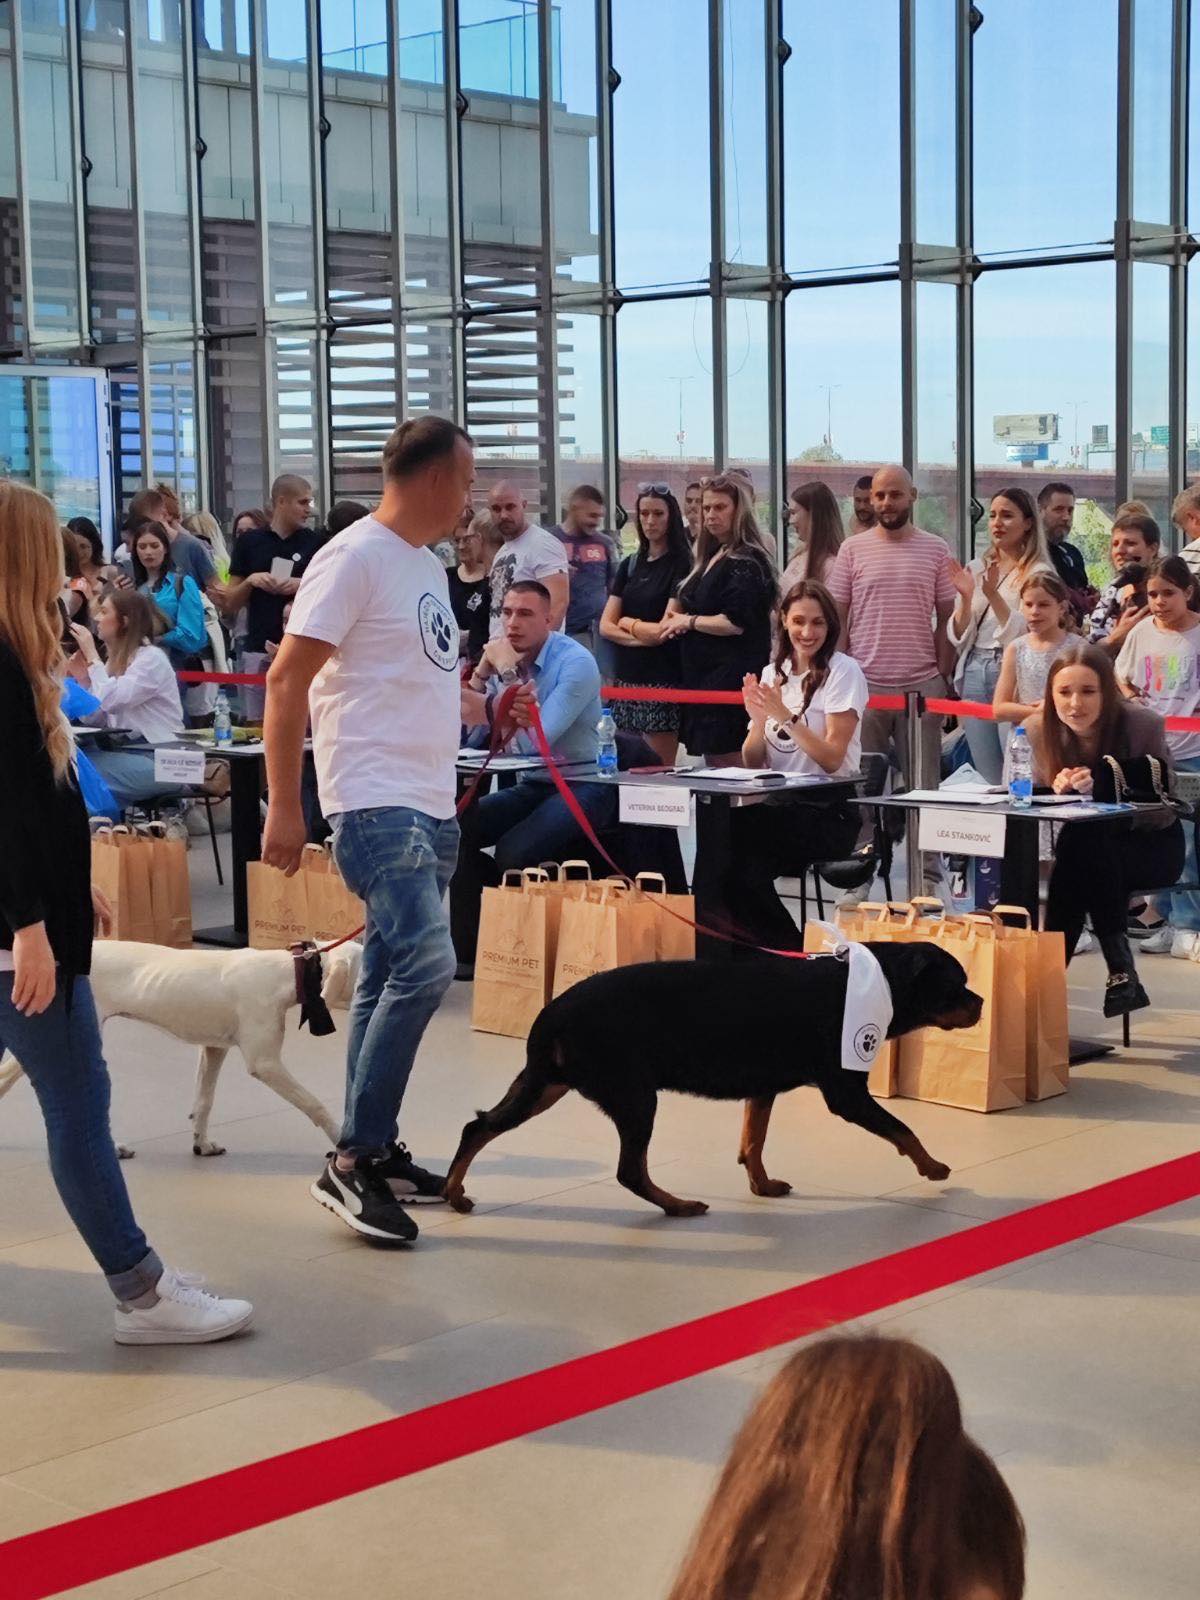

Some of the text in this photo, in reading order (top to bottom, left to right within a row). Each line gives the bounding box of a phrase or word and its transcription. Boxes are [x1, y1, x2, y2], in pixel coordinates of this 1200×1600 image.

[627, 803, 686, 813] VETERINA BEOGRAD
[936, 829, 992, 843] LEA STANKOVIĆ
[482, 950, 540, 969] PREMIUM PET
